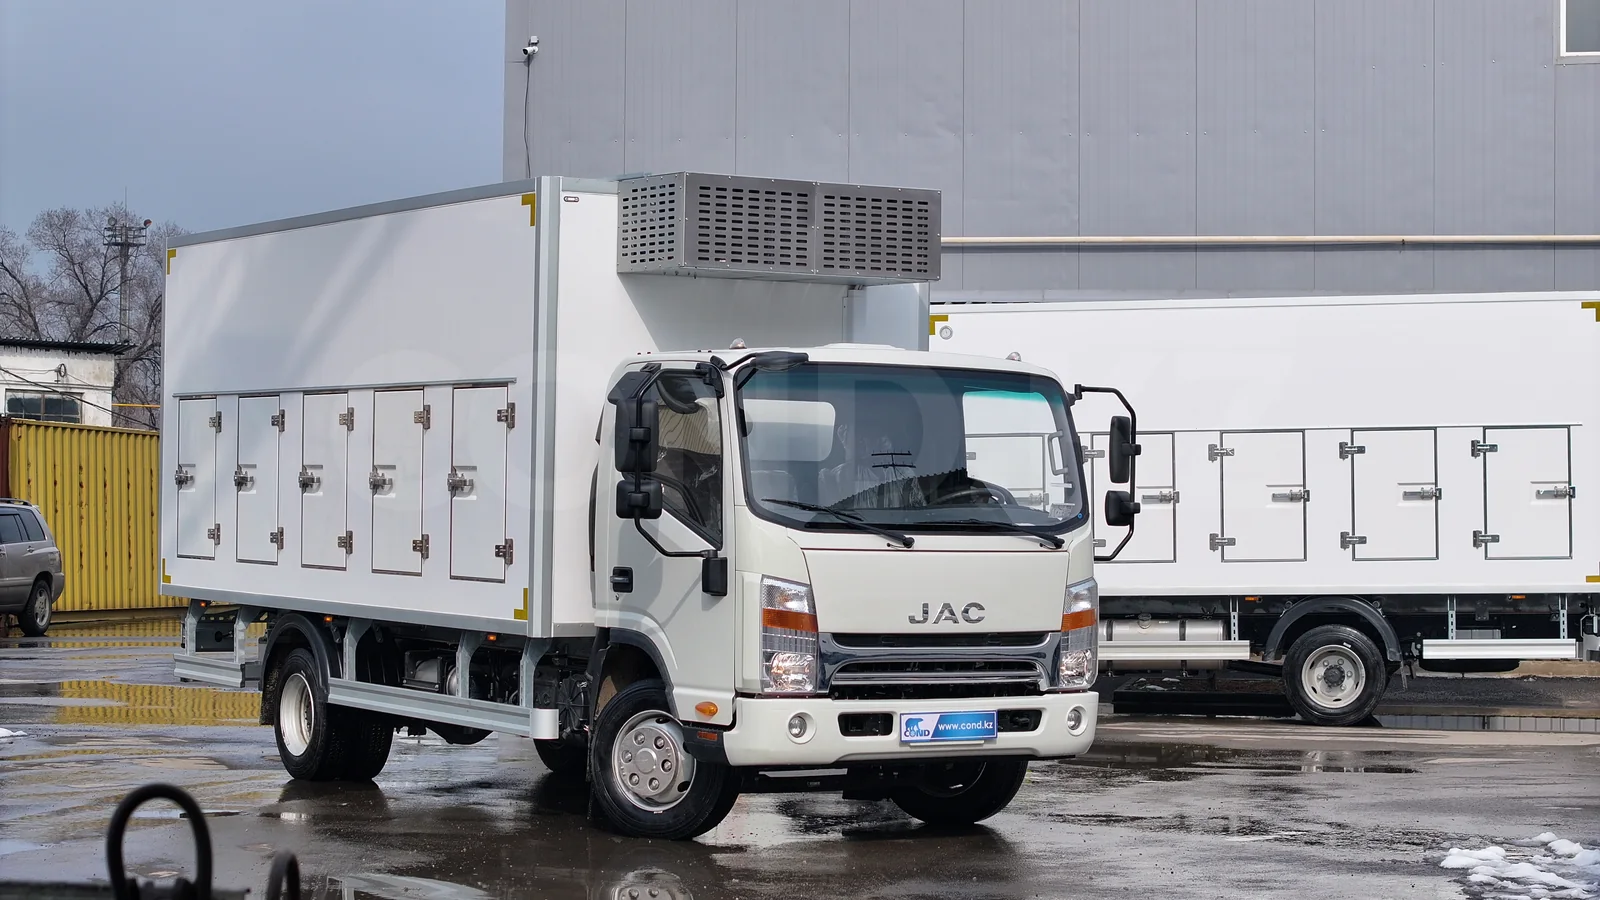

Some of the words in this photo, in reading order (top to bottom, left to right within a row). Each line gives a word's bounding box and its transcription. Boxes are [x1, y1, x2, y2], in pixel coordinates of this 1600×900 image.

[908, 602, 986, 625] JAC
[938, 720, 993, 731] www.cond.kz
[904, 729, 930, 738] COND
